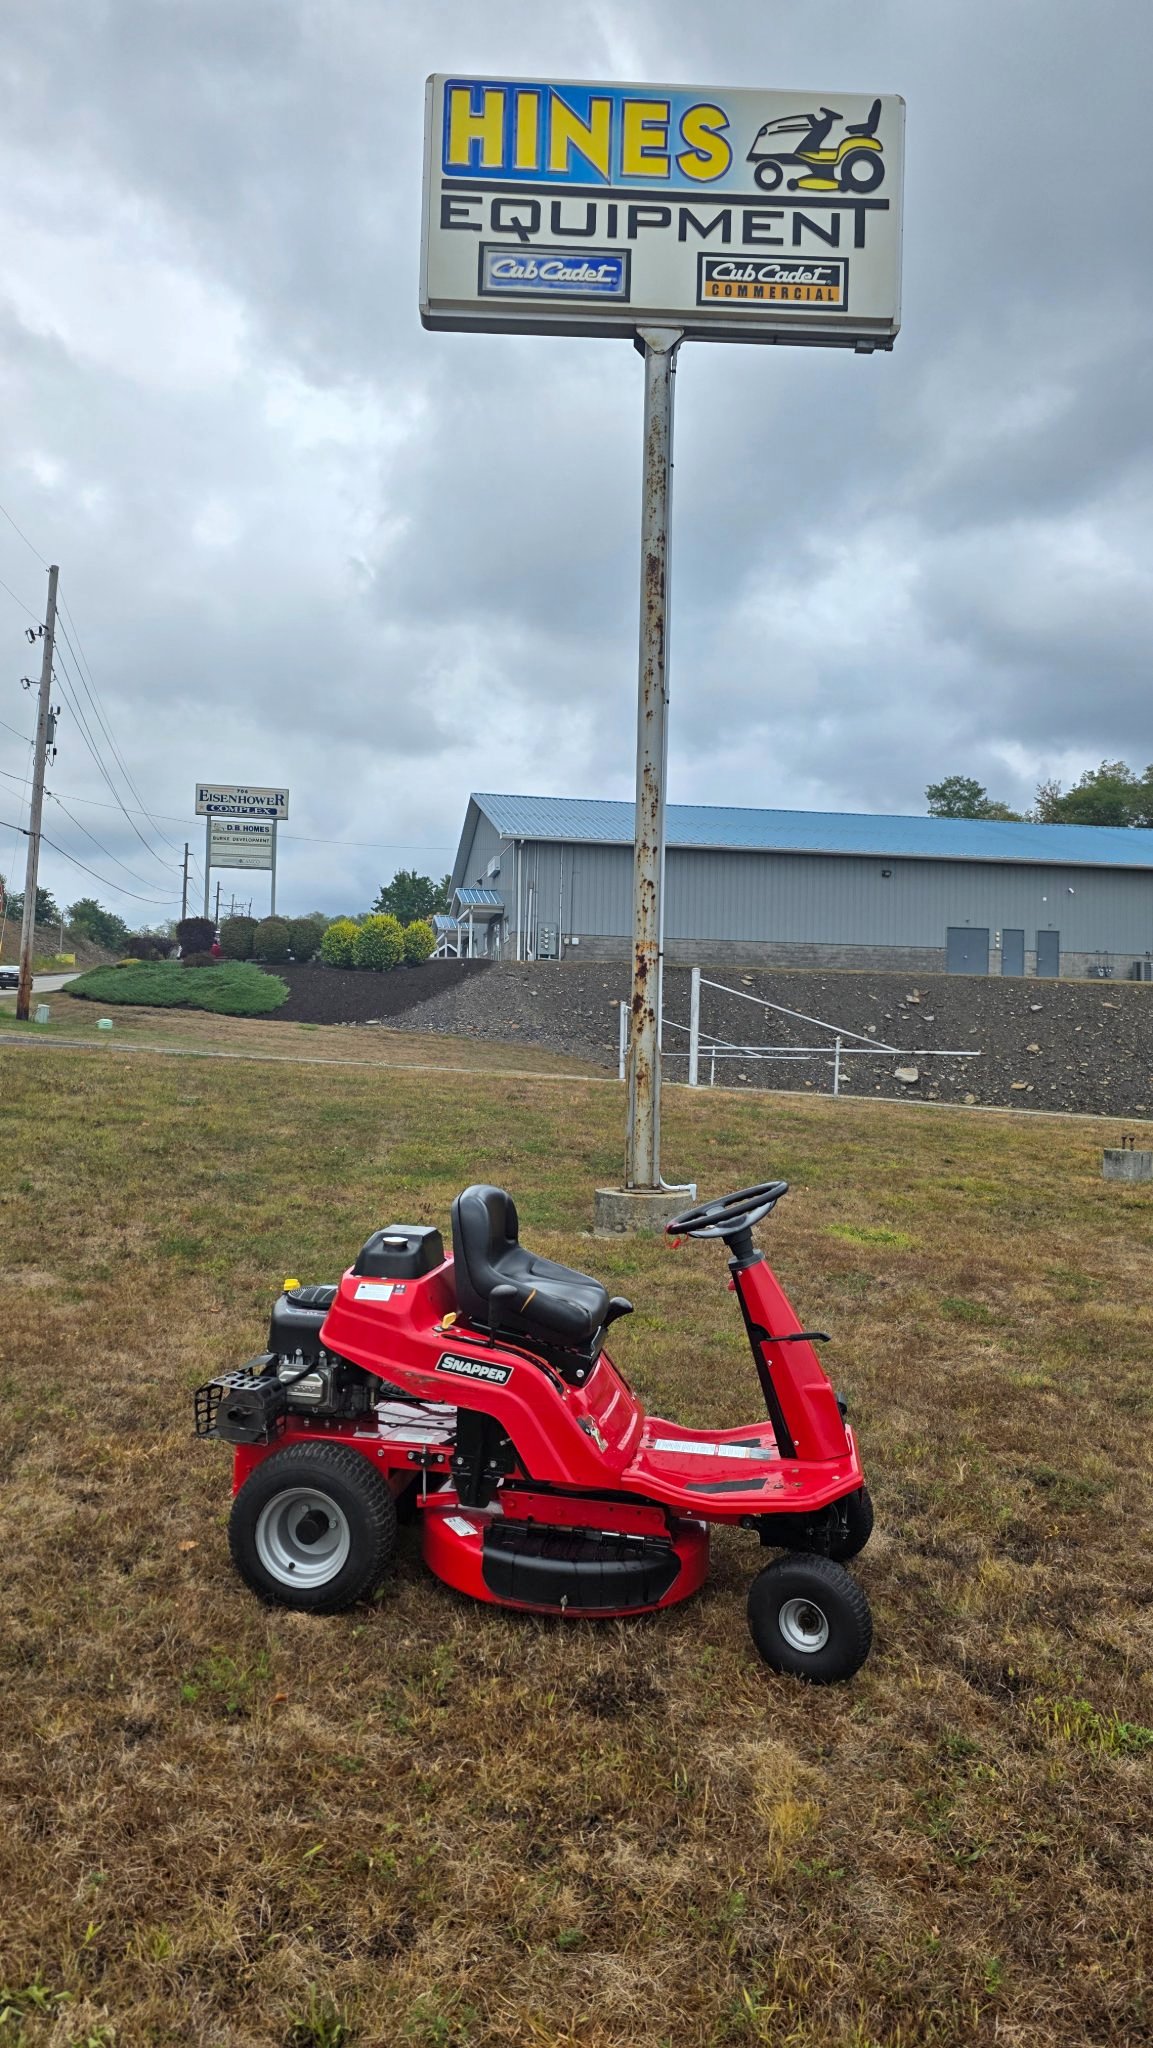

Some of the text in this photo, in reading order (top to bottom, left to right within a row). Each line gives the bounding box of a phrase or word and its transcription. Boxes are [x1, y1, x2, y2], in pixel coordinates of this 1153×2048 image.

[446, 85, 733, 184] HINES
[440, 194, 889, 249] EQUIPMENT
[491, 259, 617, 283] Cub Cadet
[712, 263, 832, 285] Cub Cadet
[712, 284, 834, 301] COMMERCIAL
[210, 805, 271, 814] COMPLEX
[243, 825, 270, 833] HOMES
[441, 1356, 507, 1382] SNAPPER
